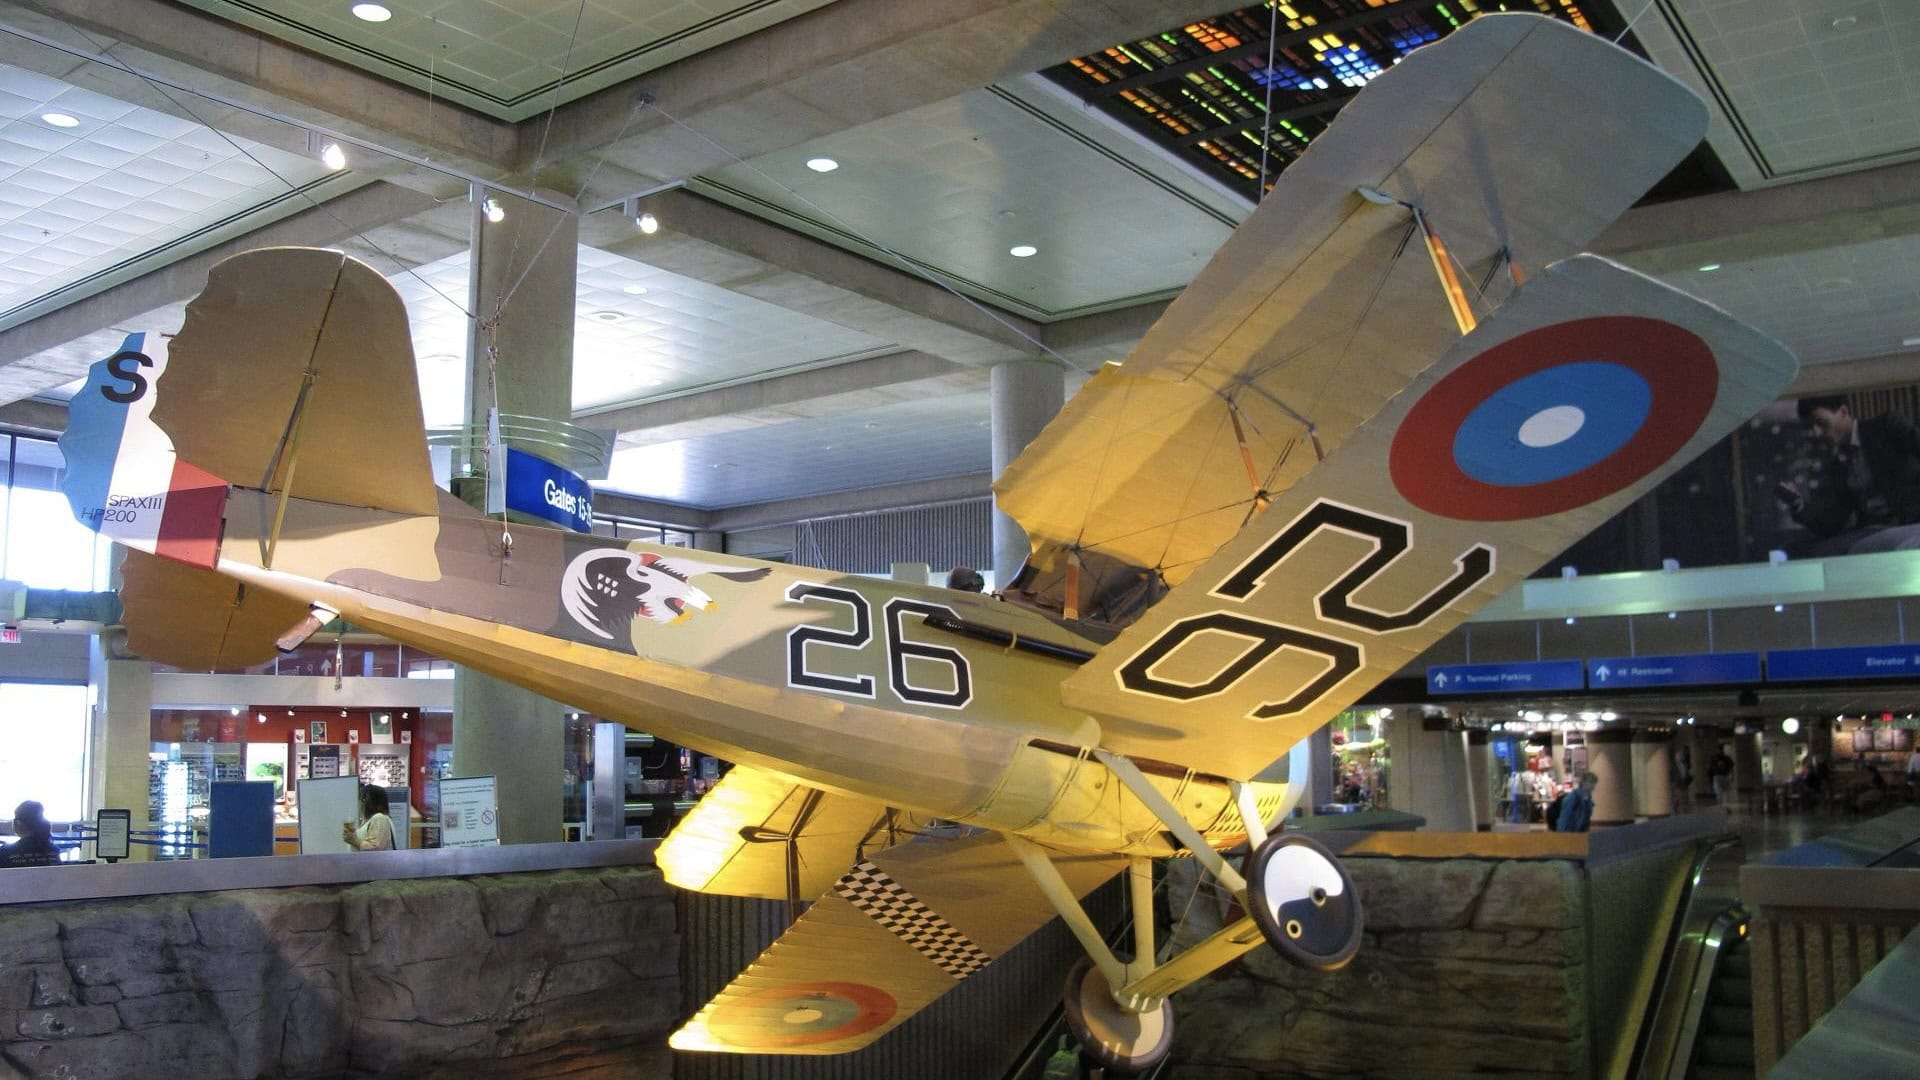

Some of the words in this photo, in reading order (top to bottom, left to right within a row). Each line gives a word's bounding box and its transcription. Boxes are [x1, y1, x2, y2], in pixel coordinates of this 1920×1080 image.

[101, 352, 153, 404] S
[544, 479, 577, 515] Gates
[784, 580, 974, 710] 26
[1866, 656, 1907, 666] Elevator
[1466, 674, 1499, 682] Terminal
[1500, 673, 1532, 682] Parking
